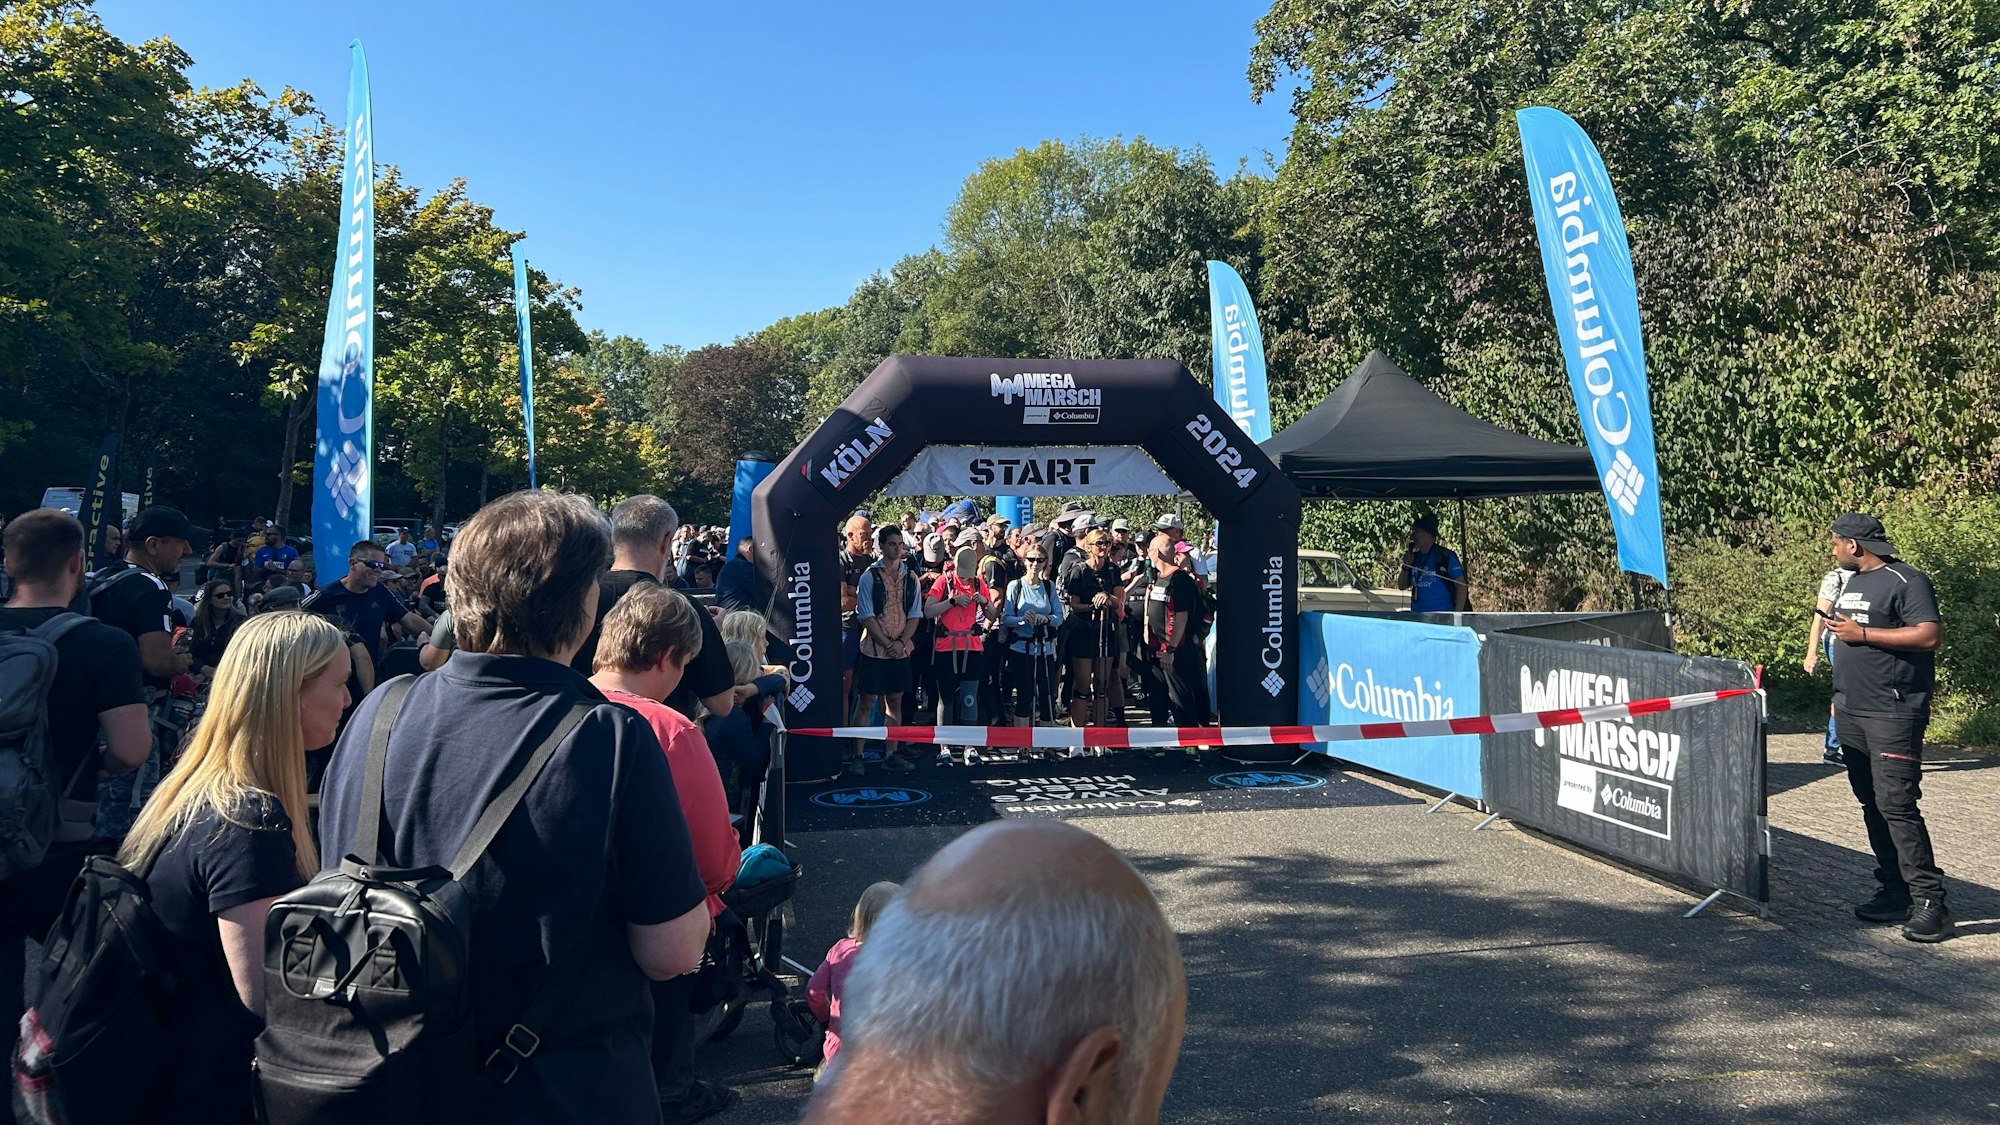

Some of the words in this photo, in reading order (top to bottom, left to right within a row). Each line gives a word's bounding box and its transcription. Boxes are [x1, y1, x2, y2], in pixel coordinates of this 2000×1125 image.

[1023, 373, 1076, 389] MEGA
[1024, 388, 1101, 406] MARSCH
[1061, 412, 1095, 420] Columbia
[820, 416, 893, 488] KÖLN
[1185, 413, 1258, 489] 2024
[969, 458, 1096, 485] START
[787, 561, 813, 683] Columbia
[1261, 555, 1283, 670] Columbia
[1336, 663, 1454, 722] Columbia
[1560, 721, 1681, 781] MARSCH
[990, 787, 1170, 803] ALWAYS
[1015, 782, 1131, 793] KEEP
[1005, 800, 1166, 813] Columbia
[1612, 787, 1662, 820] Columbia
